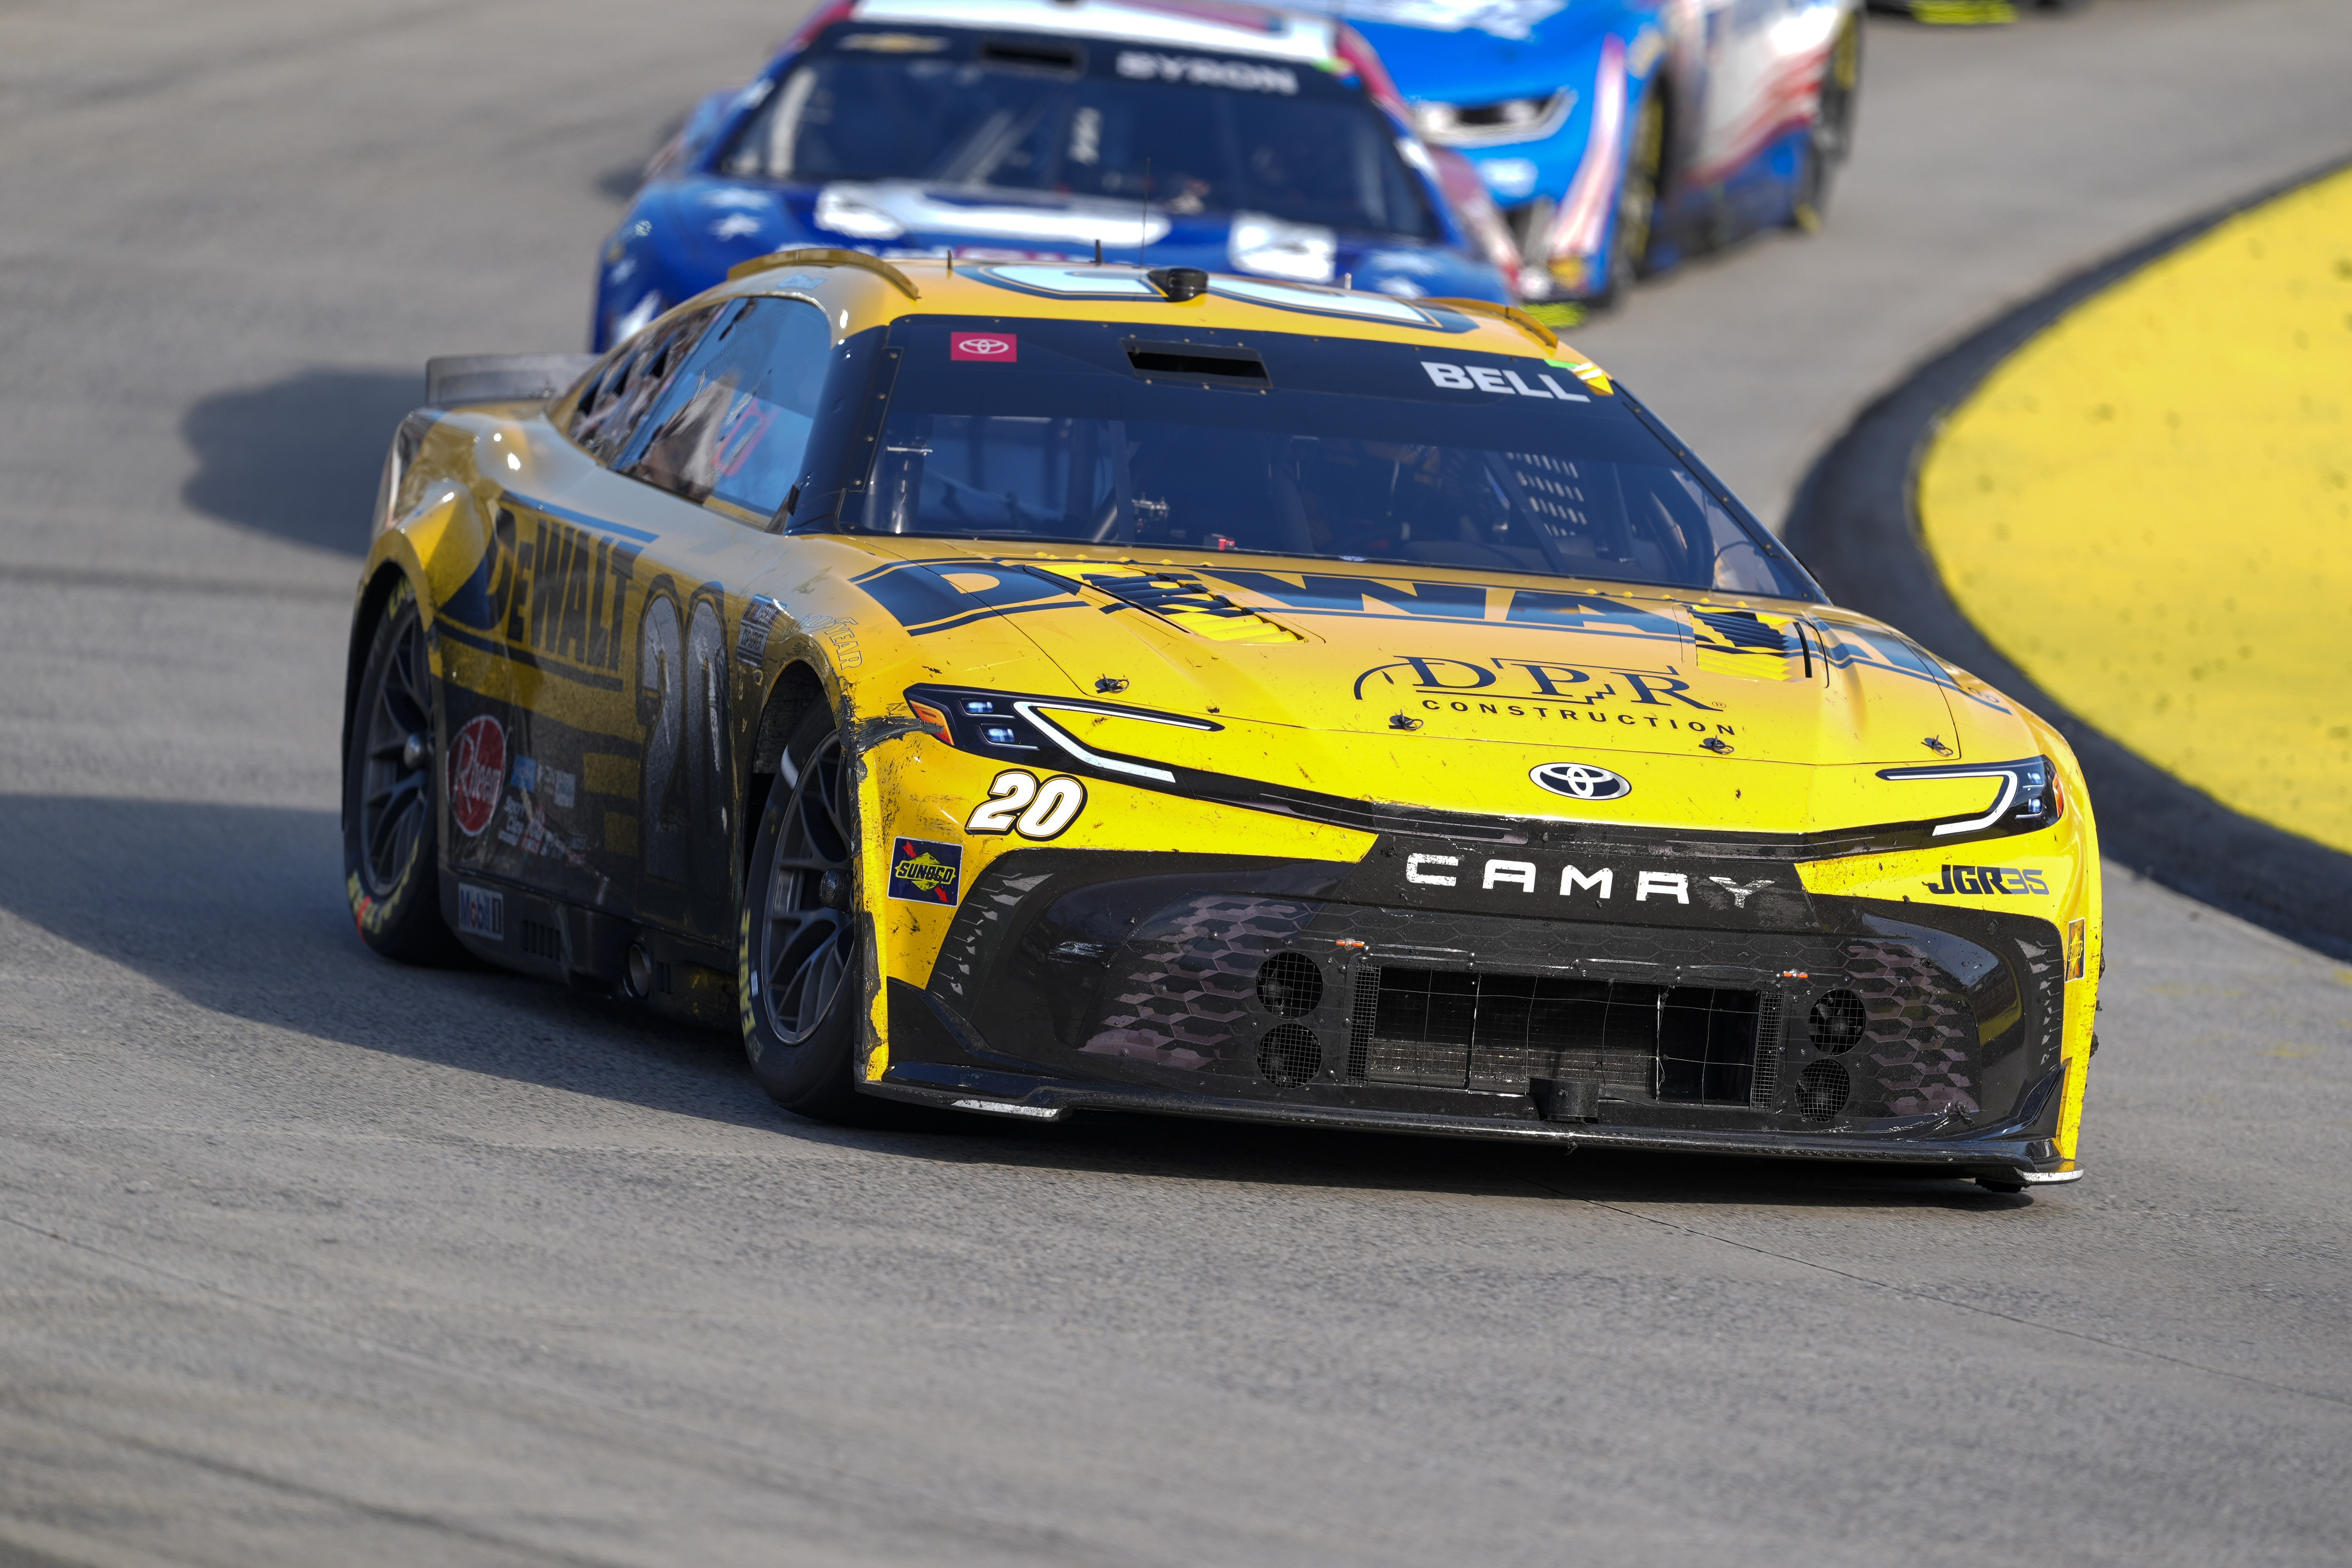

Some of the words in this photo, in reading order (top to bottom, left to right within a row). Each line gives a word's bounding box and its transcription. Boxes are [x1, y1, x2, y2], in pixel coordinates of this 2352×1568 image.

[1421, 361, 1591, 403] BELL
[1422, 700, 1735, 735] CONSTRUCTION
[452, 720, 502, 814] Rheem
[964, 768, 1088, 842] 20
[897, 862, 954, 883] SUNOCO
[1406, 853, 1775, 909] CAMRY
[460, 890, 490, 931] Mobil
[492, 898, 502, 933] 1
